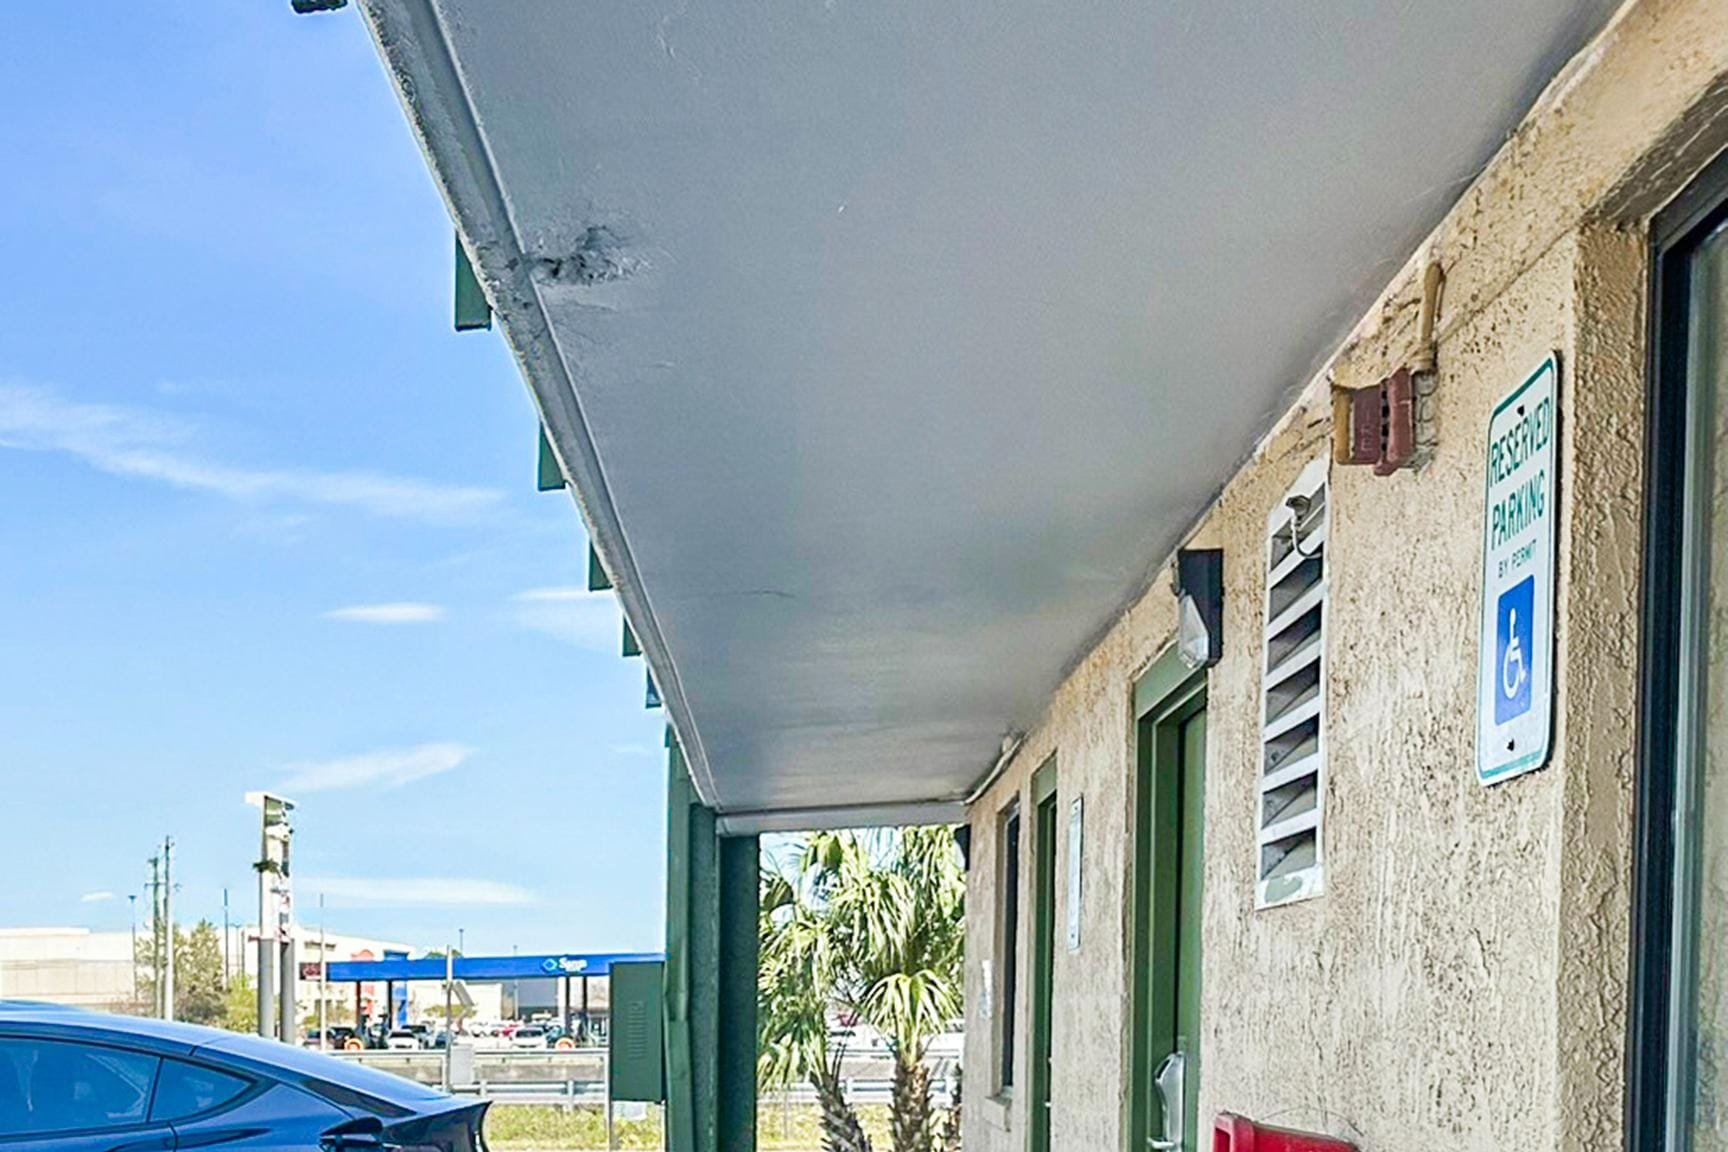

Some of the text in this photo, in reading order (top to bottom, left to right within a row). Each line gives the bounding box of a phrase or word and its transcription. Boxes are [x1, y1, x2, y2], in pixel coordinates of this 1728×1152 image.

[1488, 396, 1550, 488] RESERVED
[1491, 469, 1545, 551] PARKING
[1498, 539, 1537, 578] BY PERMIT
